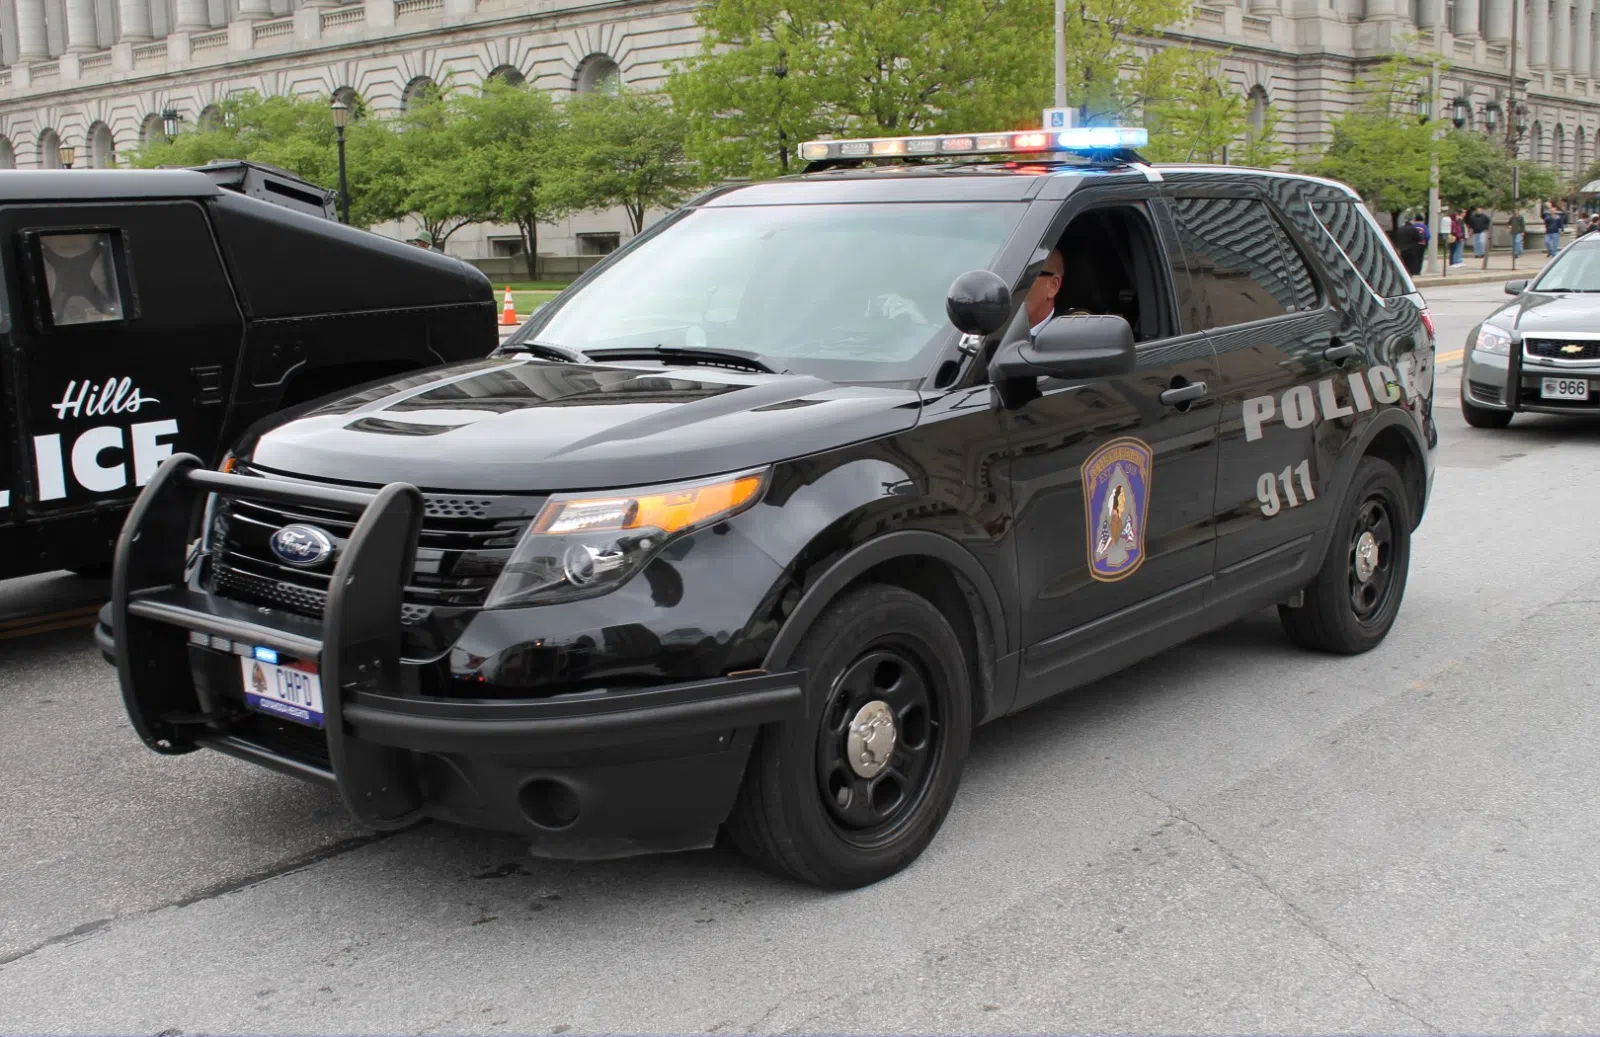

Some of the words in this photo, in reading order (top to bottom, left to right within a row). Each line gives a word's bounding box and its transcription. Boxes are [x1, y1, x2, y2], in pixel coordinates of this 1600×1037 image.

[51, 376, 161, 420] Hills
[1242, 360, 1418, 443] POLICE
[1558, 380, 1586, 396] 966
[0, 419, 179, 508] ICE
[1256, 459, 1316, 517] 911
[278, 531, 313, 557] Ford
[276, 668, 313, 707] CHPD
